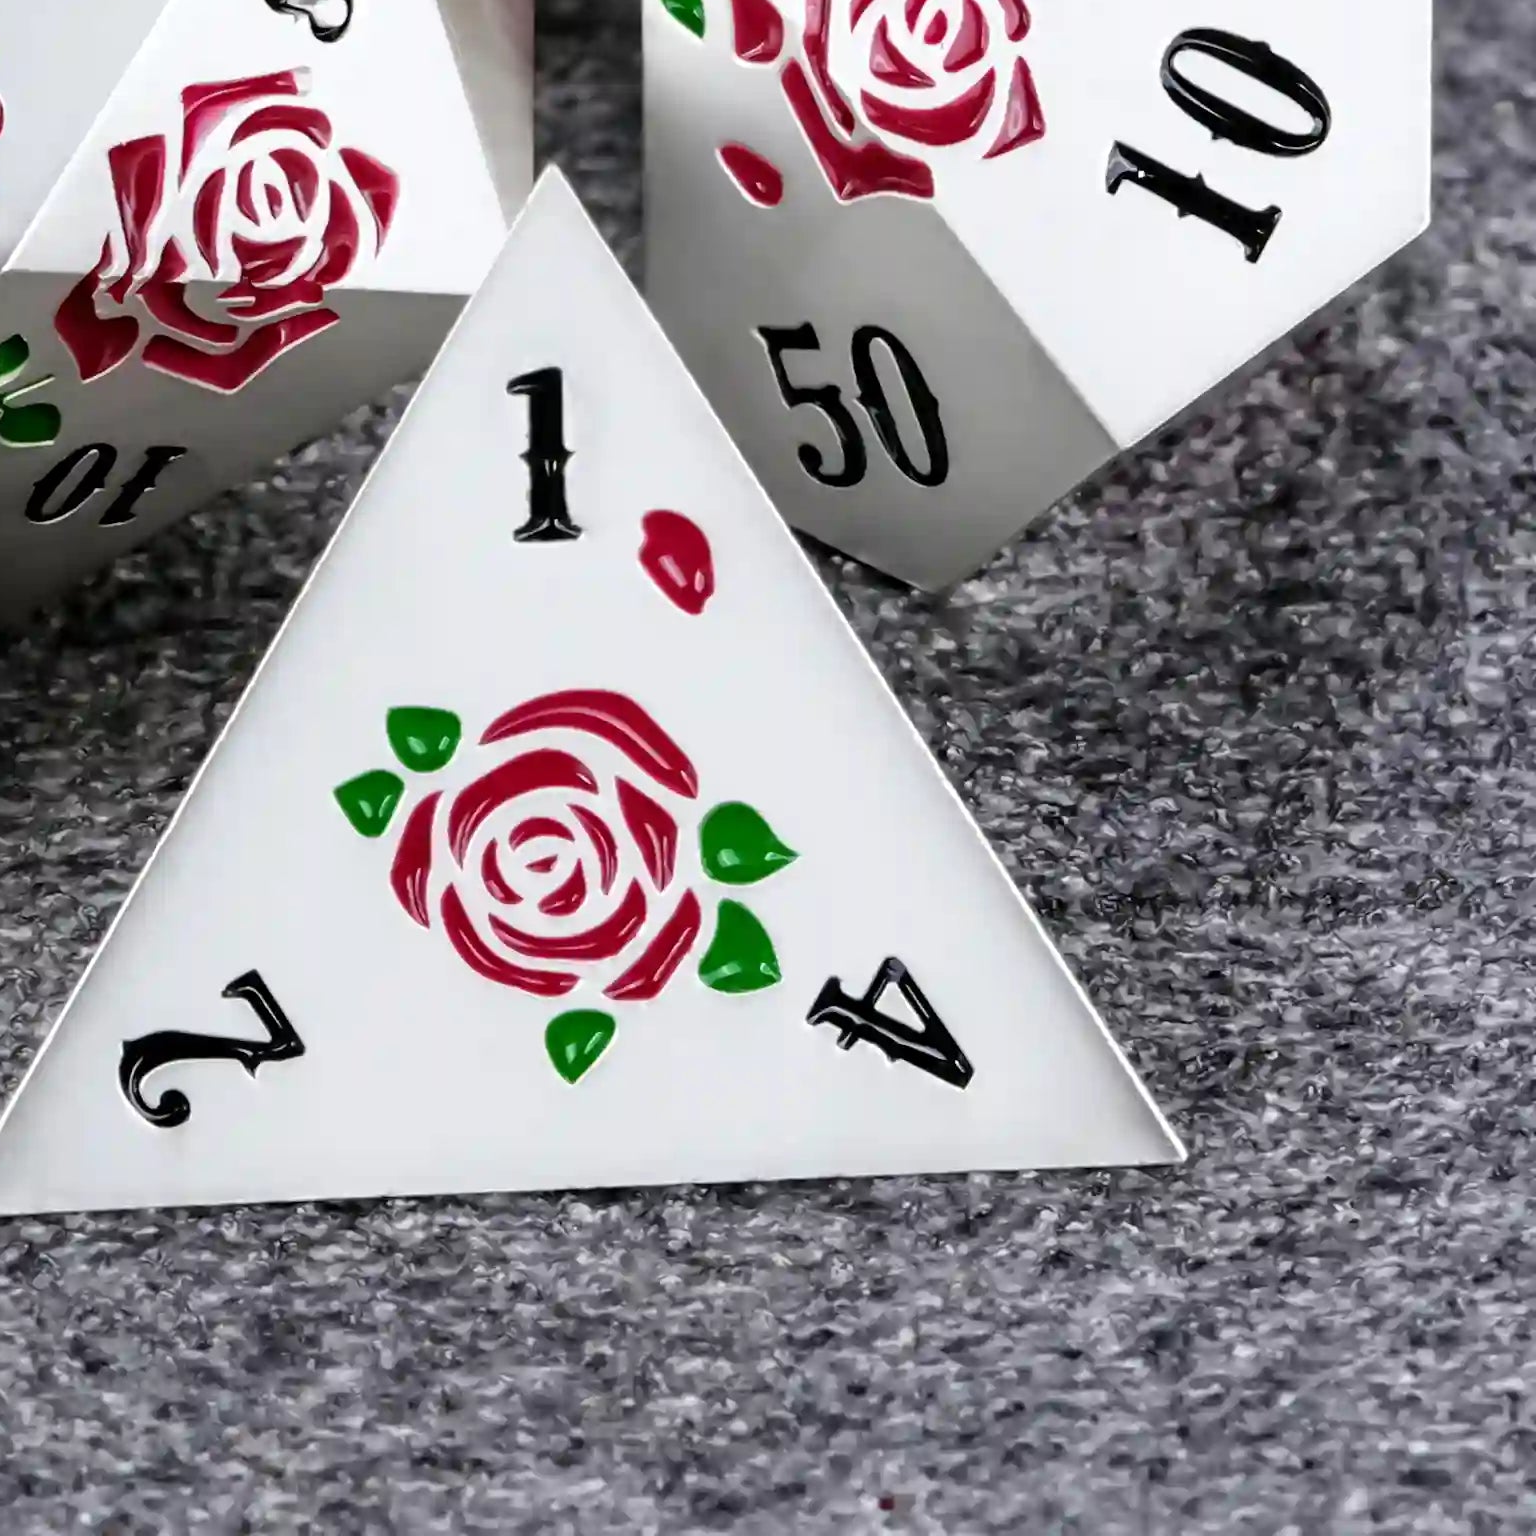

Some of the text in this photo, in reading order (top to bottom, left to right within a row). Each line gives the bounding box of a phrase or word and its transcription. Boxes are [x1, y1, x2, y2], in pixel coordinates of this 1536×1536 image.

[1106, 28, 1331, 263] 10
[507, 367, 581, 542] 1
[758, 322, 949, 487] 50
[119, 970, 305, 1128] 2
[806, 957, 974, 1089] 4
